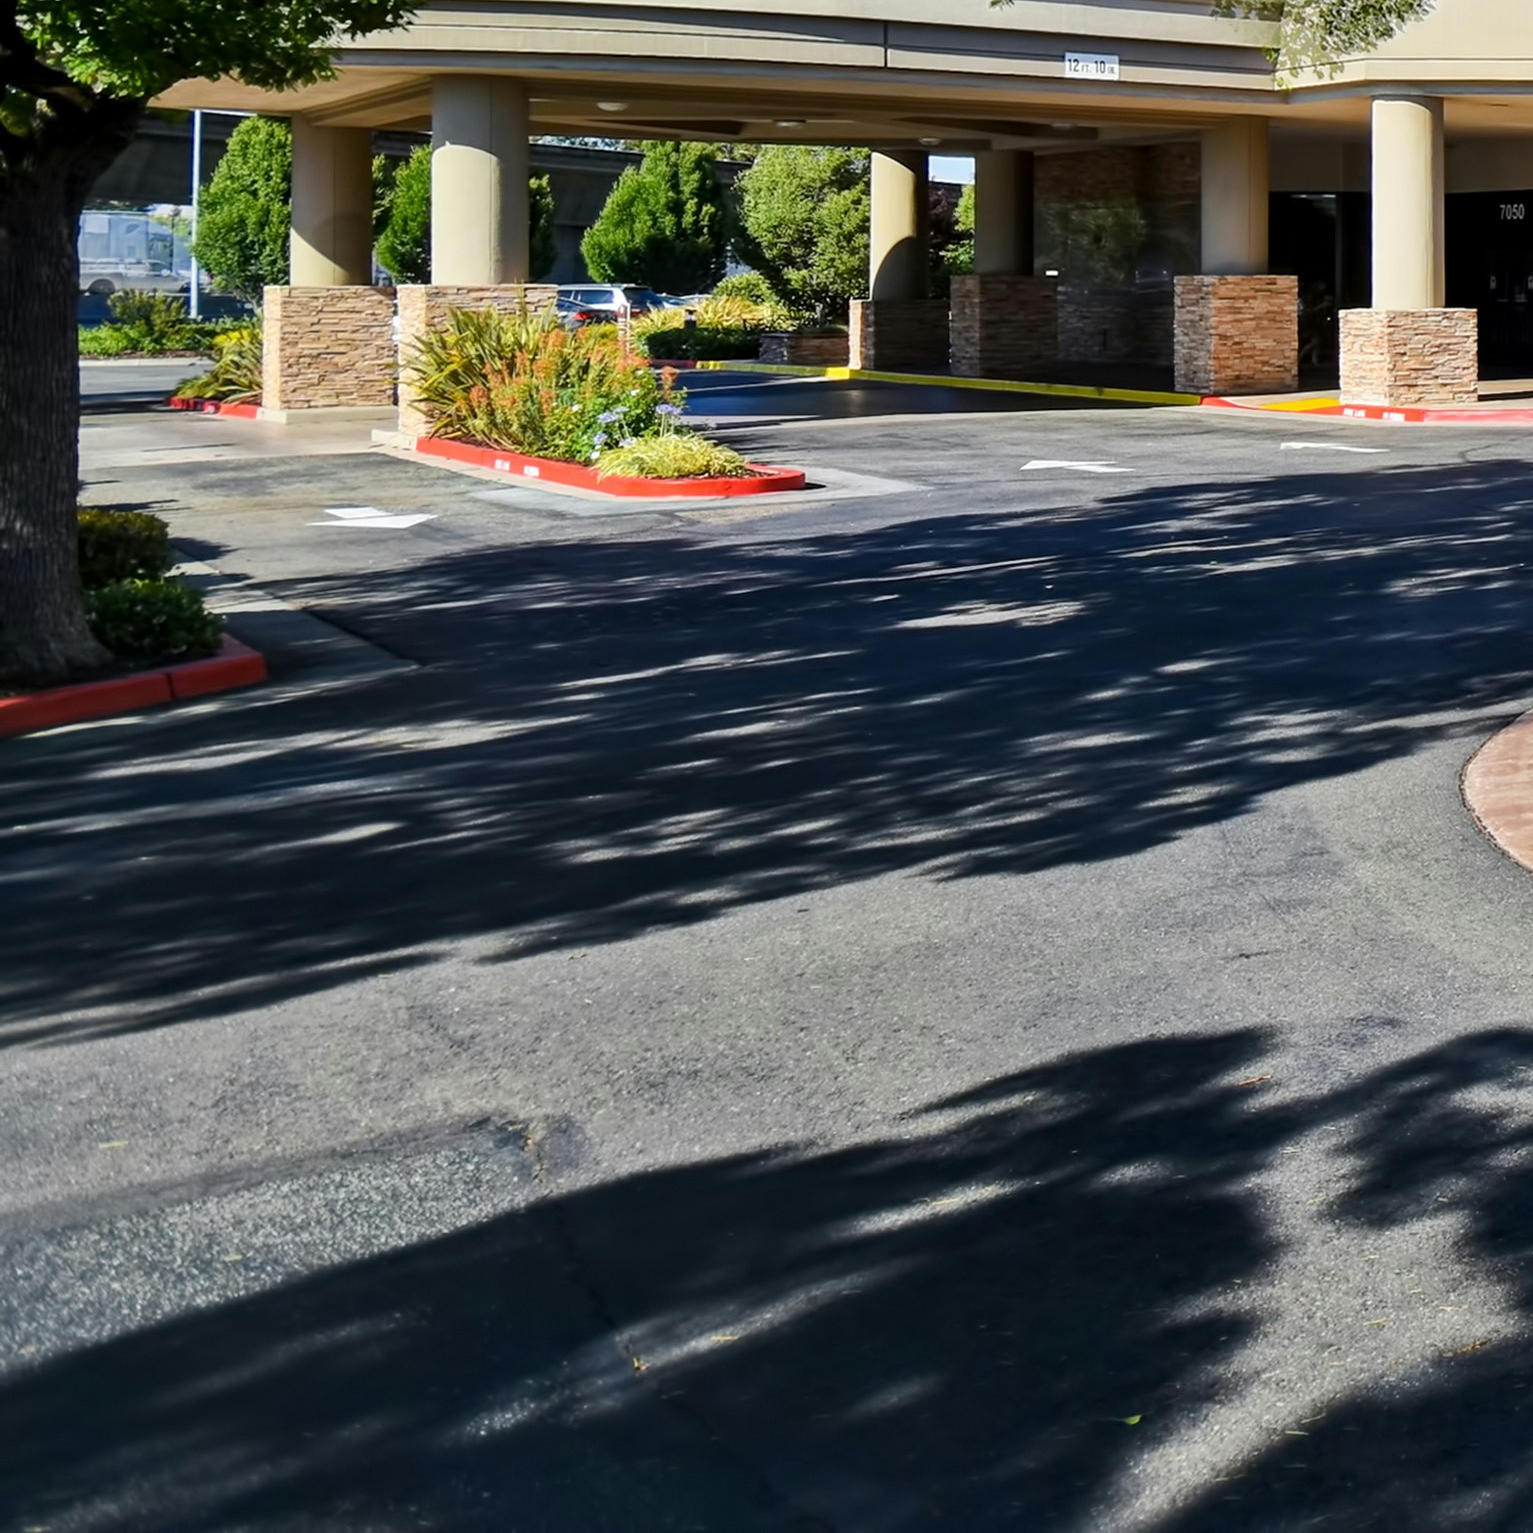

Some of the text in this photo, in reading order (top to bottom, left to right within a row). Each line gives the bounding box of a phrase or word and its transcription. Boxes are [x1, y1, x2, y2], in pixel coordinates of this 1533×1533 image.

[1067, 58, 1080, 73] 12
[1094, 60, 1106, 74] 10
[1499, 203, 1525, 220] 7050
